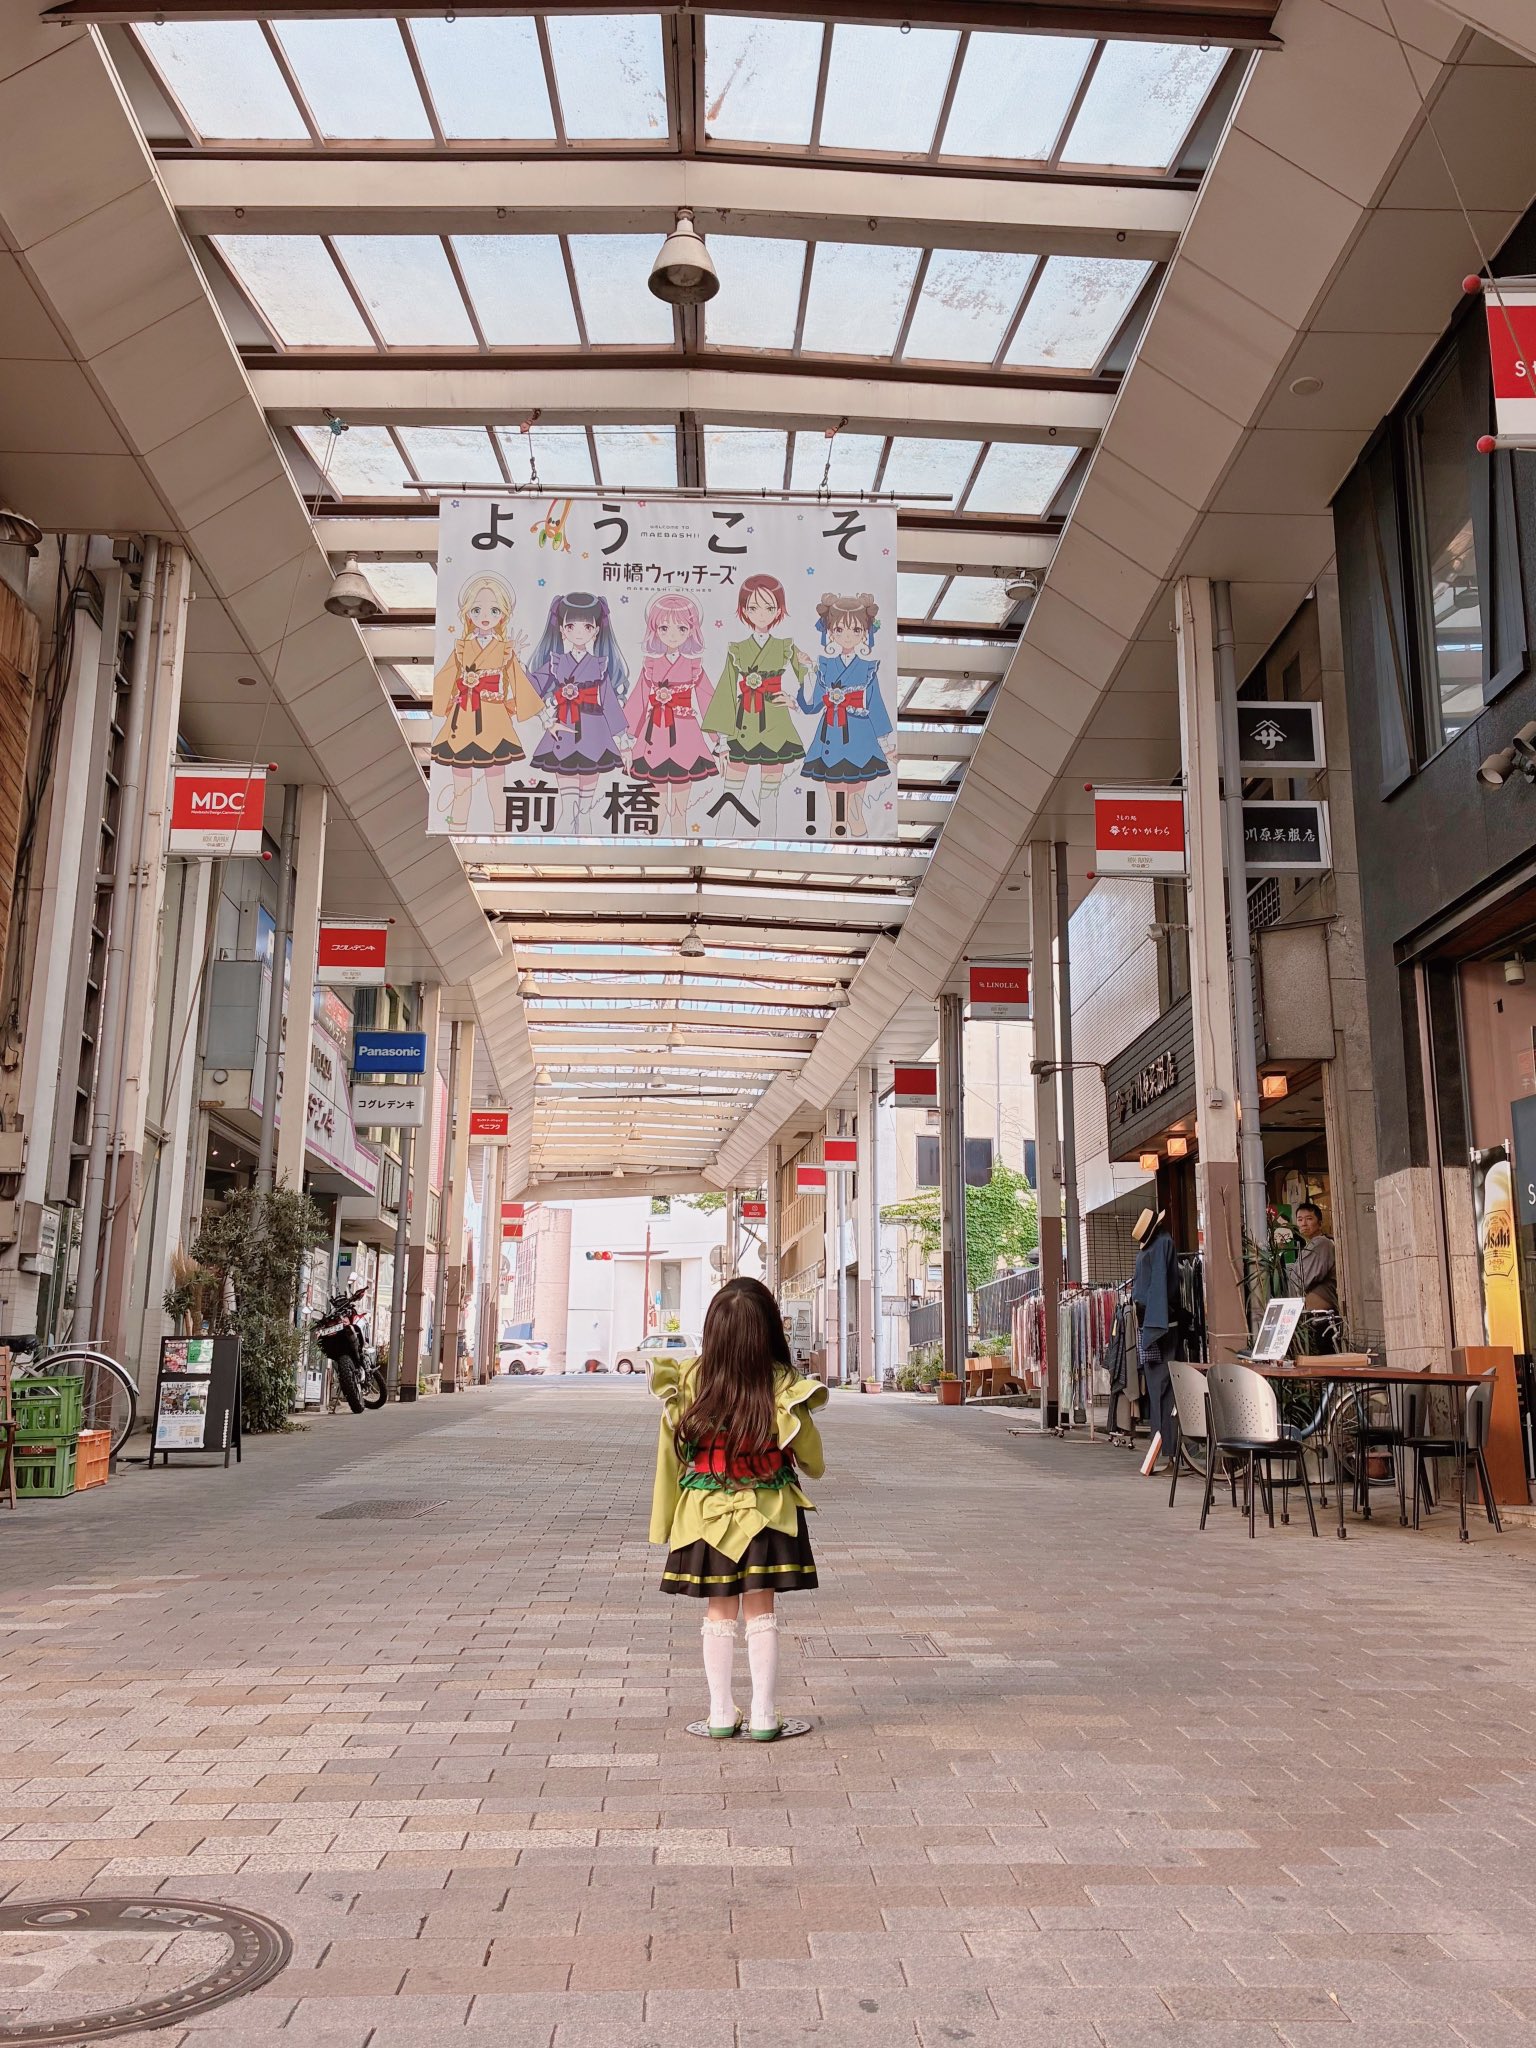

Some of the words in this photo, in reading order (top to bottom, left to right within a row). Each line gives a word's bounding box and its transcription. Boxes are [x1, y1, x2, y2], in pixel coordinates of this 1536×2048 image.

[602, 561, 737, 585] 前橋ウィッチーズ
[191, 791, 246, 811] MDC
[1121, 825, 1170, 836] なかがわら
[358, 1045, 421, 1057] Panasonic
[358, 1099, 416, 1109] コグレデンキ
[1484, 1228, 1511, 1251] Asahi
